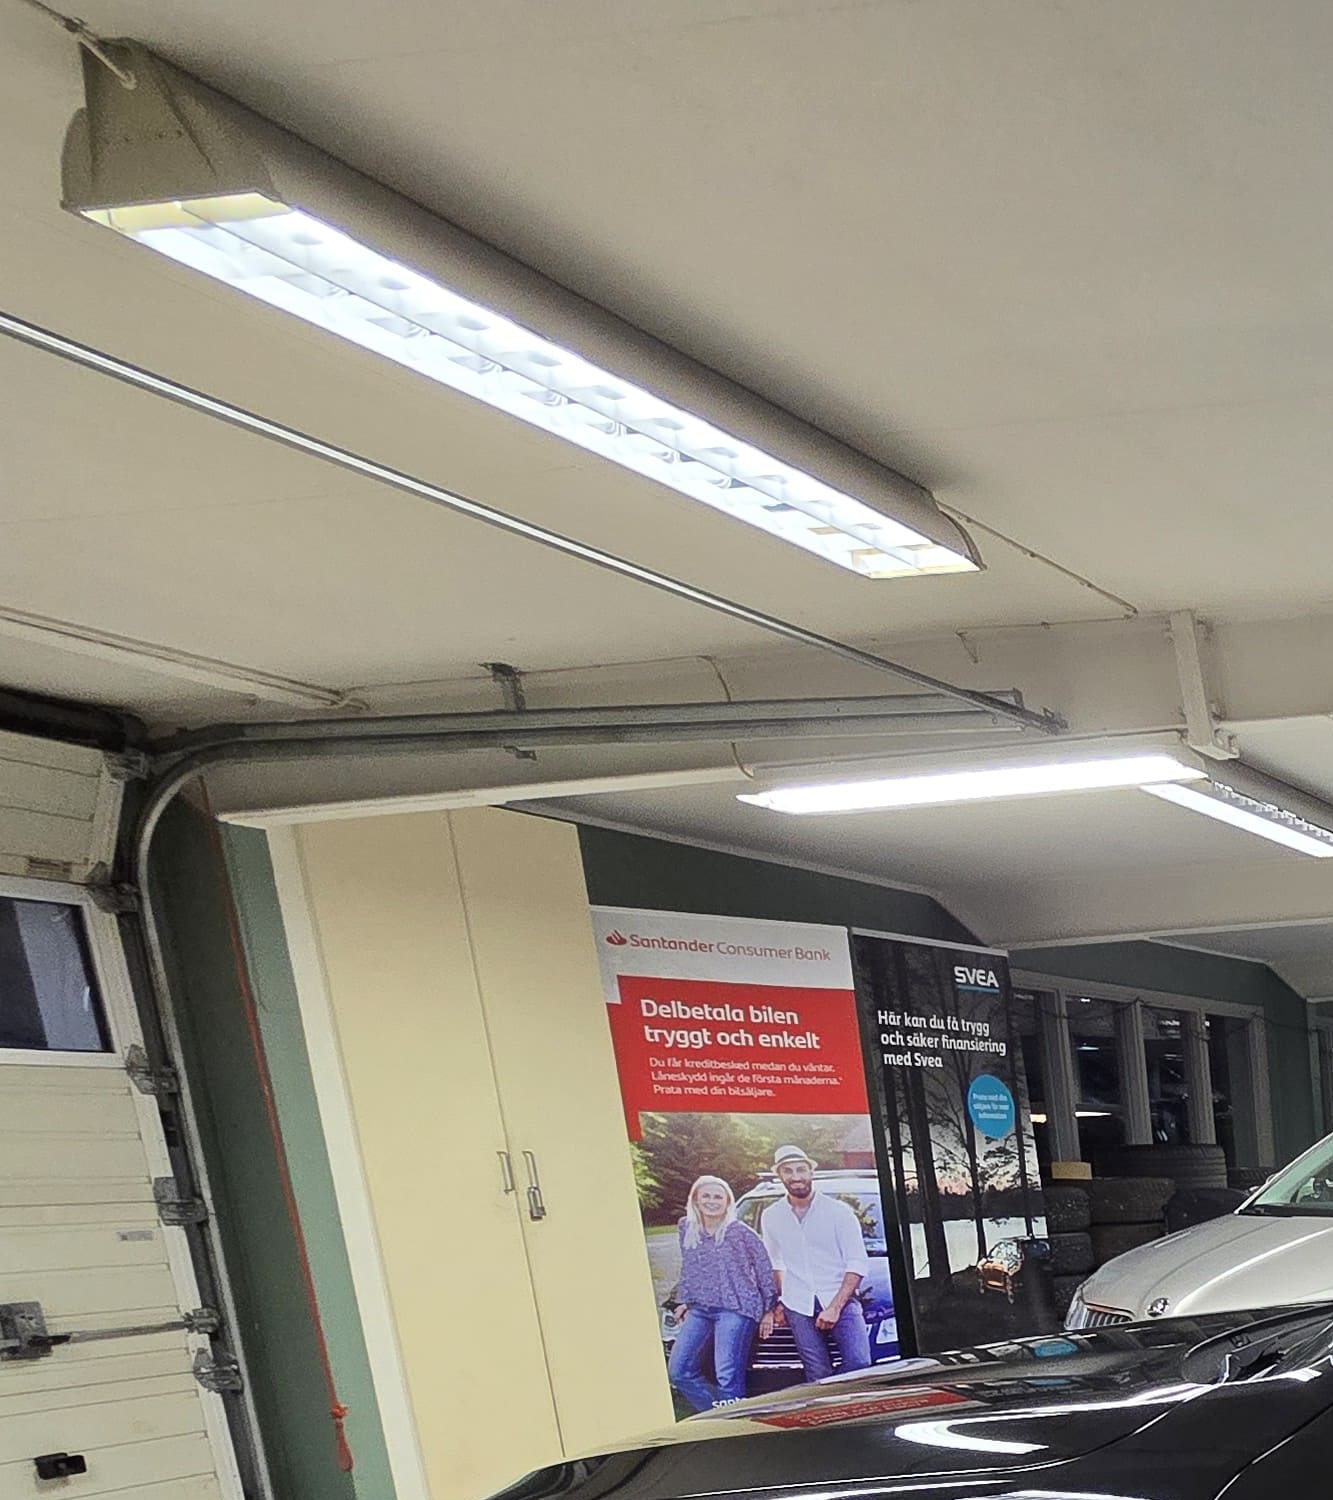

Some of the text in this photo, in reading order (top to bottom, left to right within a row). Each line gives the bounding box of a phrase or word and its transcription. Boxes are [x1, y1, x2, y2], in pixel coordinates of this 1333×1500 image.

[630, 934, 832, 961] Santander Consumer Bank
[954, 966, 999, 988] SVEA
[640, 999, 799, 1025] Delbetala bilen
[877, 1010, 990, 1037] Här kan du få trygg
[644, 1025, 821, 1050] tryggt och enkelt
[880, 1031, 1007, 1057] och säker finansiering
[649, 1057, 665, 1068] Du
[752, 1062, 786, 1071] medan
[788, 1062, 801, 1072] du
[883, 1051, 944, 1068] med Svea
[653, 1084, 682, 1094] Prata
[684, 1085, 708, 1095] med
[710, 1086, 726, 1095] din
[737, 1074, 751, 1083] de
